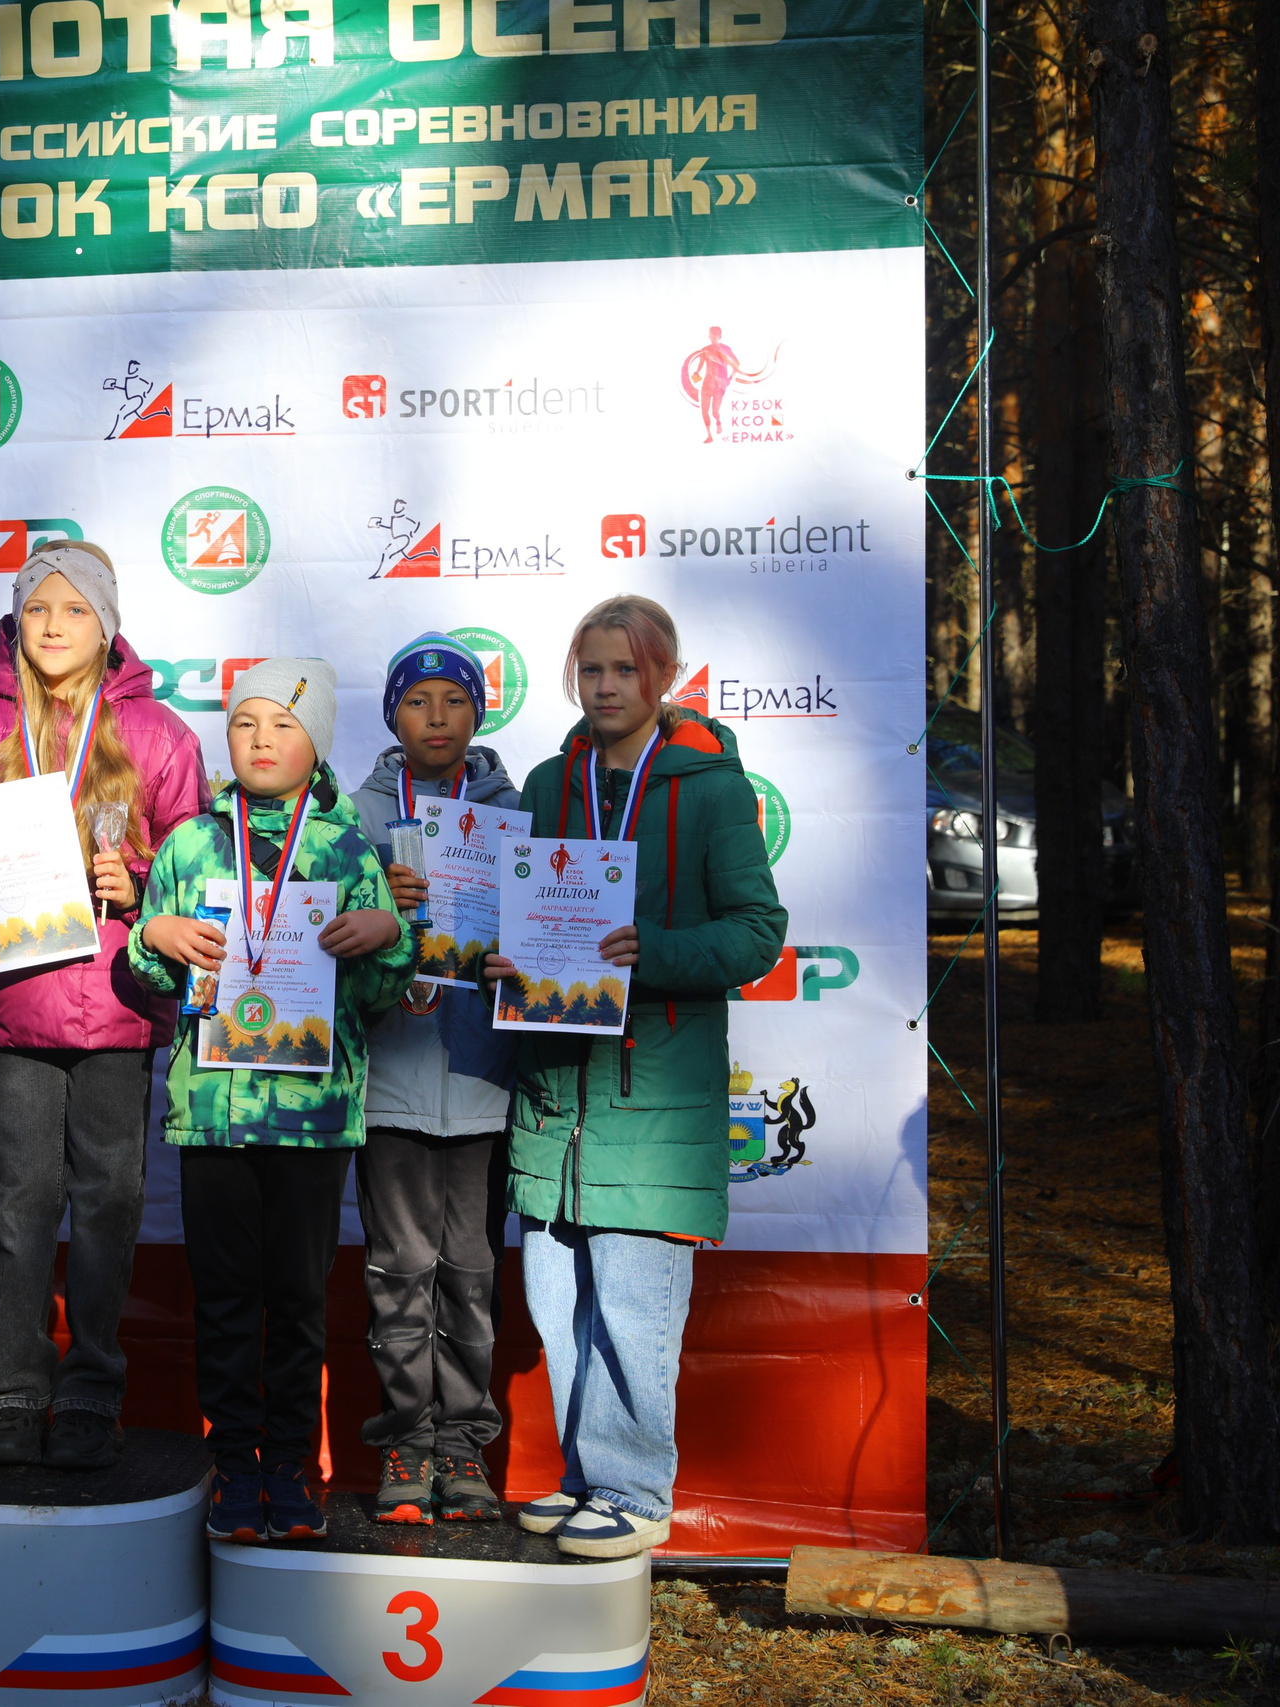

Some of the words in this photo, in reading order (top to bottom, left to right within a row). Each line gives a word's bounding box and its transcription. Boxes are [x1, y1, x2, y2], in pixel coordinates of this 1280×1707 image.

[309, 93, 757, 148] СОРЕВНОВАНИЯ
[149, 171, 317, 234] КСО
[355, 156, 757, 227] «ЕРМАК»
[183, 394, 295, 438] Ермак
[731, 399, 783, 412] КУБОК
[731, 415, 764, 427] КСО
[721, 431, 795, 444] «ЕРМАК»
[194, 491, 249, 508] СПОРТИВНОГО
[166, 500, 191, 542] ФЕДЕРАЦИЯ
[659, 516, 870, 558] SPORTident
[451, 534, 565, 578] Ермак
[750, 556, 829, 574] siberia
[500, 653, 523, 720] ОРИЕНТИРОВАНИЯ
[720, 674, 837, 720] Ермак
[768, 795, 786, 862] ОРИЕНТИРОВАНИ
[440, 845, 497, 866] ДИПЛОМ
[444, 863, 492, 877] НАГРАЖДАЕТСЯ
[468, 886, 488, 895] место
[535, 886, 600, 900] ДИПЛОМ
[541, 904, 595, 913] НАГРАЖДАЕТСЯ
[381, 1589, 444, 1683] 3
